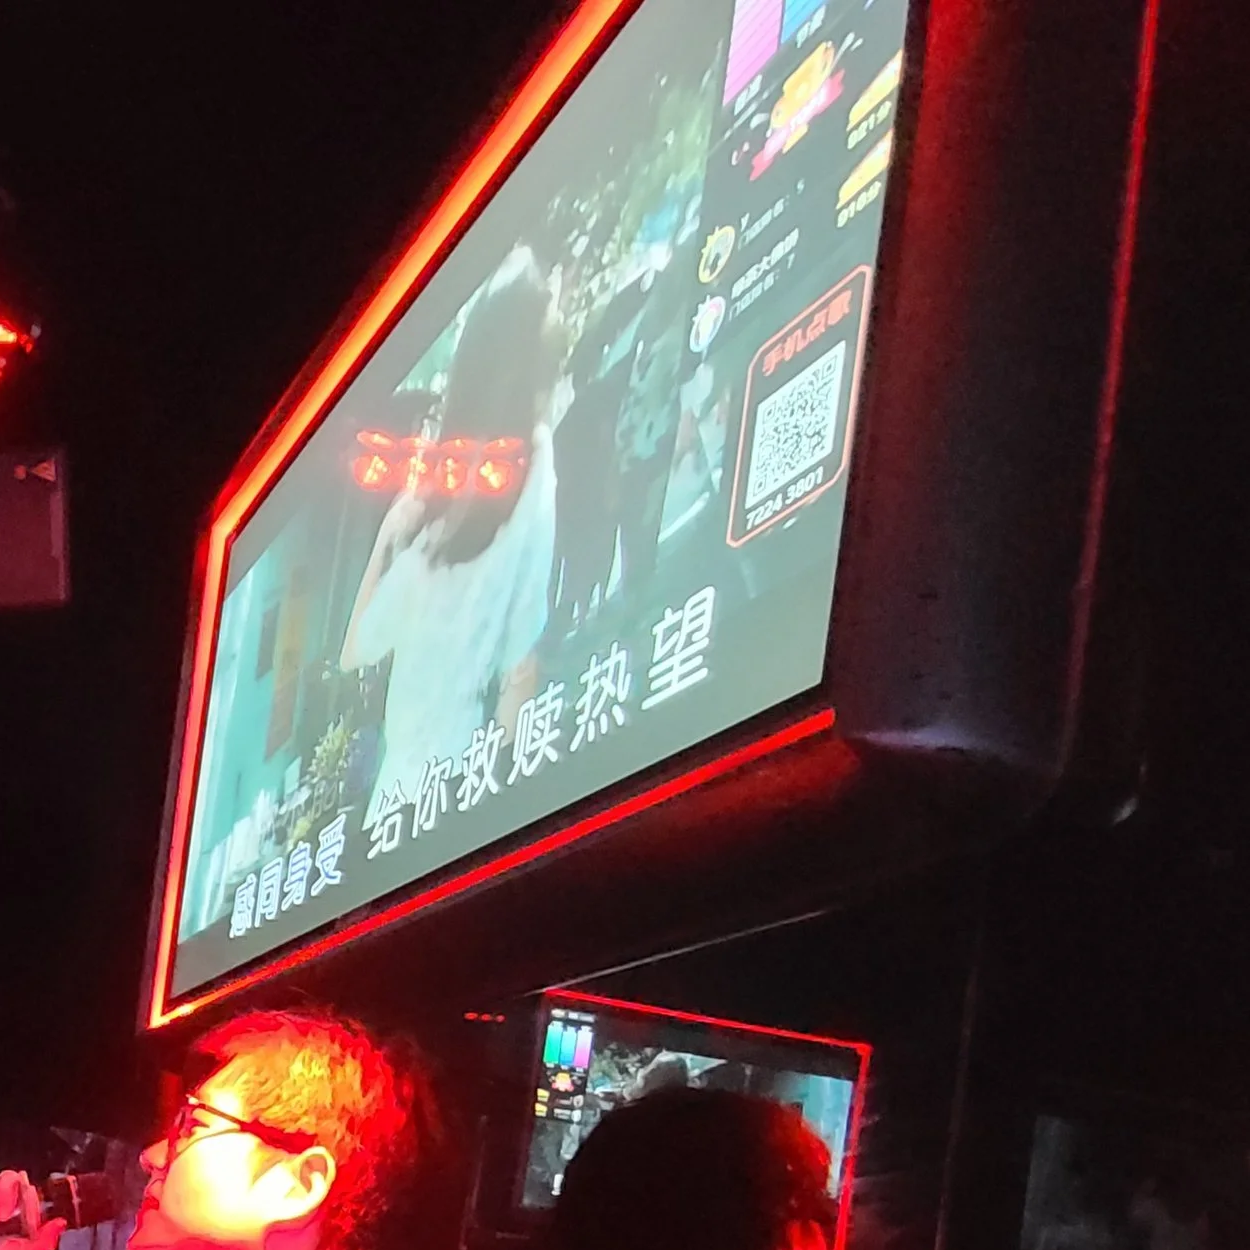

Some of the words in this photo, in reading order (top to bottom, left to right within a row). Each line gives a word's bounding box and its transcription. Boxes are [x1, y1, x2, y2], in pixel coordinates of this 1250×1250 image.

[229, 813, 347, 938] 感同身受
[367, 585, 716, 861] 给你救赎热望
